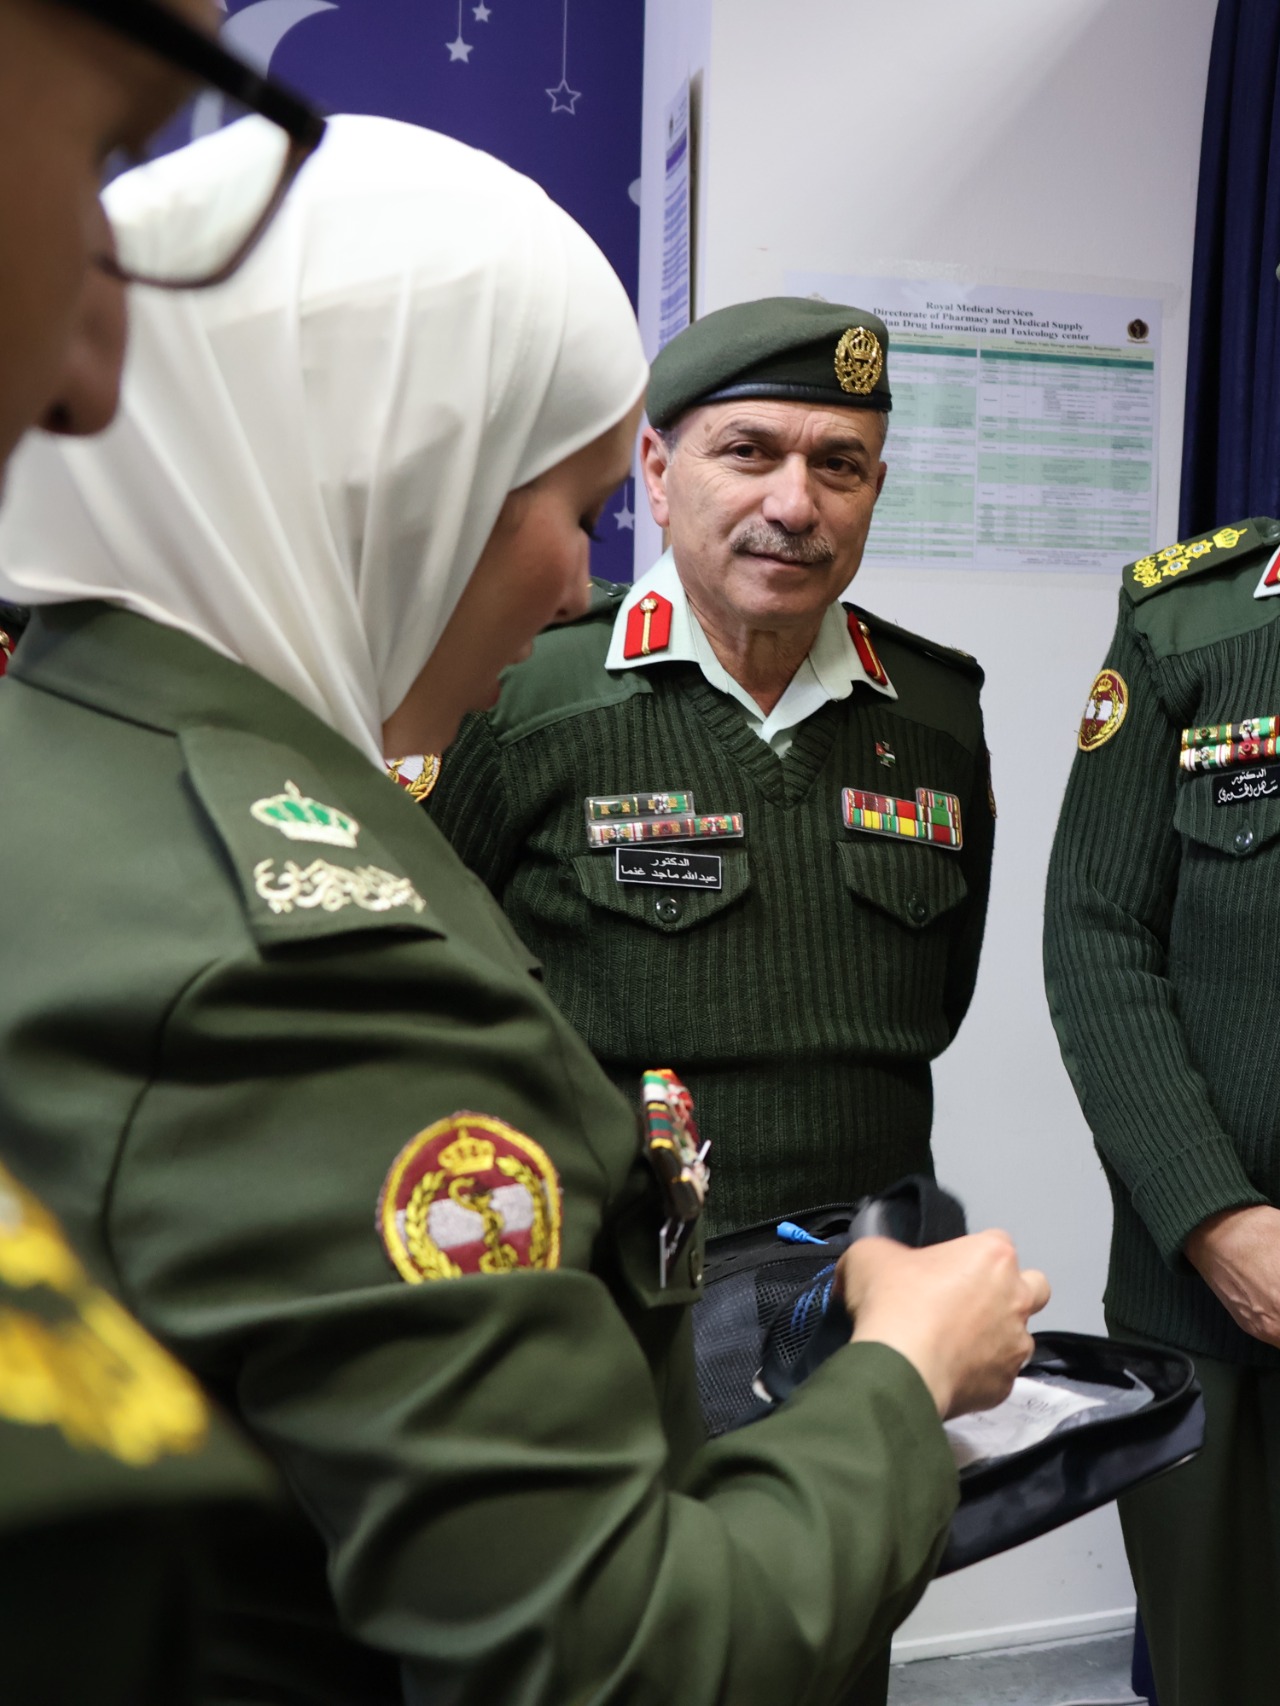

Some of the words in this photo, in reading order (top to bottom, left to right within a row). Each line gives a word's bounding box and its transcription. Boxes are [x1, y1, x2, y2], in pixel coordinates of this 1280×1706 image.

[926, 301, 954, 312] Royal
[956, 303, 994, 314] Medical
[996, 306, 1034, 317] Services
[872, 307, 928, 319] Directorate
[930, 312, 939, 320] of
[942, 312, 989, 325] Pharmacy
[992, 314, 1010, 325] and
[1012, 317, 1050, 328] Medical
[1052, 320, 1084, 332] Supply
[902, 319, 928, 331] Drug
[930, 321, 987, 333] Information
[990, 327, 1007, 335] and
[1011, 327, 1059, 340] Toxicology
[1062, 332, 1090, 341] center
[1231, 768, 1267, 785] الدكتور
[650, 857, 690, 867] الدكتور
[651, 869, 680, 880] ماجد
